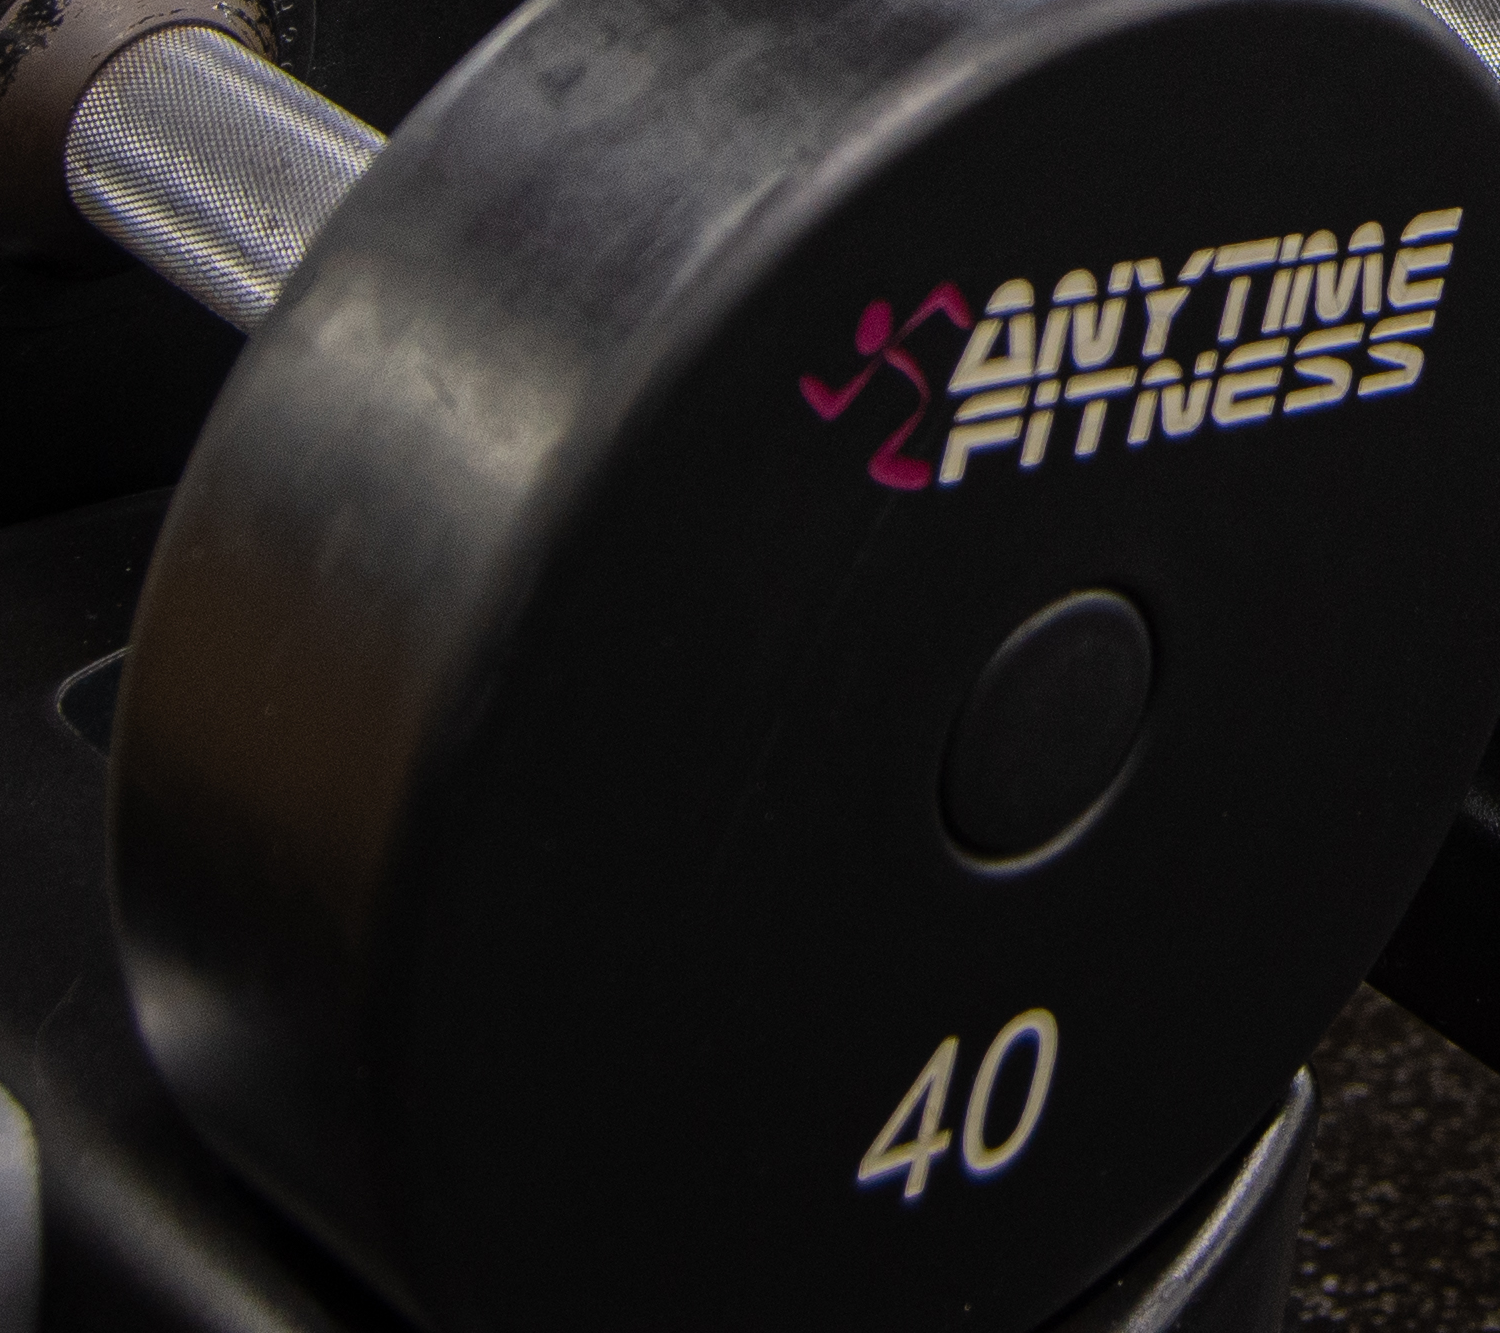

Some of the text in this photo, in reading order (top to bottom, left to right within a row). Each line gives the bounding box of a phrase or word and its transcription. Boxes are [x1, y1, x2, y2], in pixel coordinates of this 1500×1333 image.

[947, 206, 1464, 395] ANYTIME
[939, 309, 1436, 486] FITNESS
[857, 1006, 1059, 1200] 40
